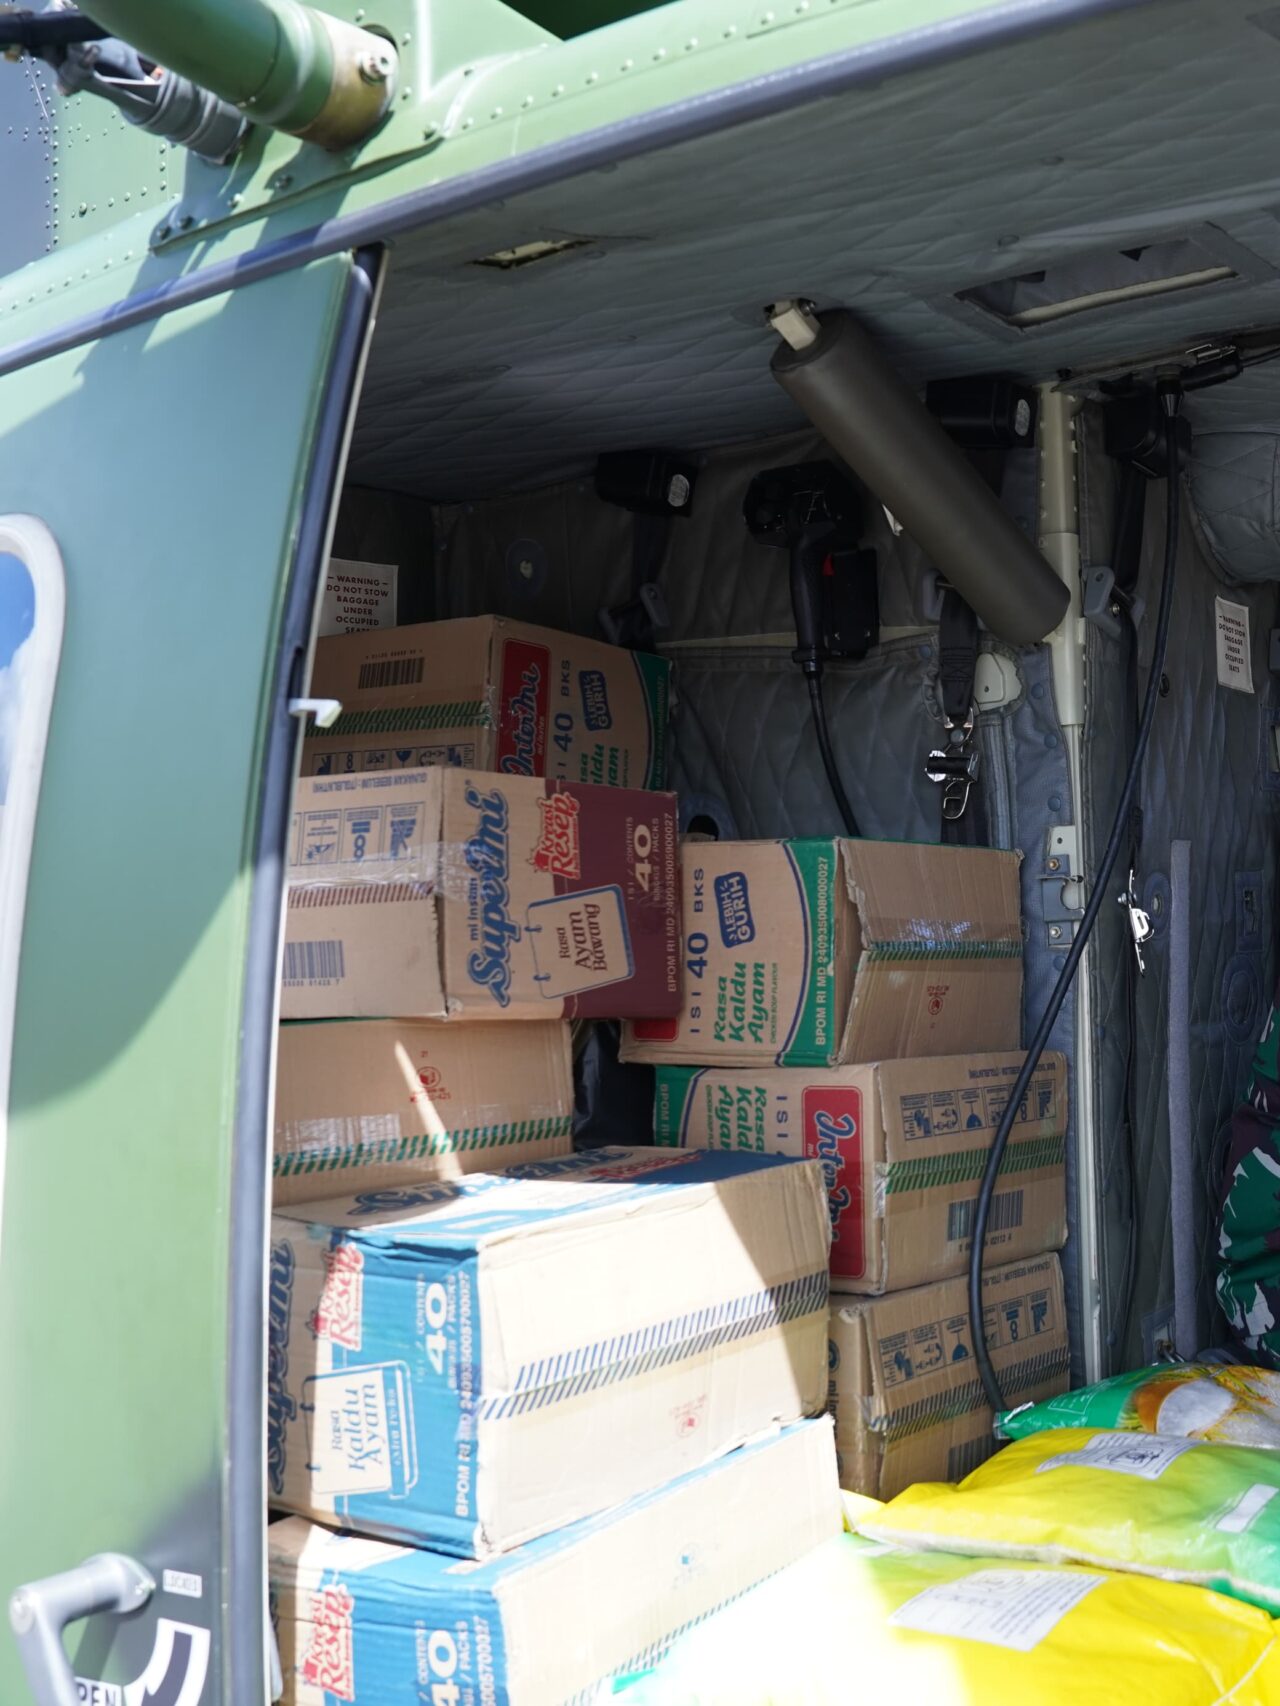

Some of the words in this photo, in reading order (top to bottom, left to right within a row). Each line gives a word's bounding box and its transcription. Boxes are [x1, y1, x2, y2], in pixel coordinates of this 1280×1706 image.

[336, 595, 379, 606] BAGGAGE
[337, 575, 380, 586] WARNING
[343, 586, 362, 594] NOT
[364, 588, 389, 597] STOW
[336, 616, 379, 626] OCCUPIED
[343, 606, 373, 615] UNDER
[561, 659, 572, 697] BKS
[593, 673, 612, 729] GURIH
[557, 712, 575, 753] 40
[592, 744, 604, 787] ldu
[540, 797, 557, 853] Kreasi
[549, 793, 582, 878] Resep
[634, 824, 651, 892] 40
[466, 784, 521, 1008] Supermi
[693, 868, 704, 914] BKS
[720, 891, 736, 931] LEBIH
[731, 876, 751, 942] GURIH
[558, 927, 571, 960] Rasa
[568, 911, 592, 969] Ayam
[584, 903, 607, 972] Bawang
[667, 920, 676, 937] MD
[667, 942, 676, 953] RI
[668, 958, 677, 993] BPOM
[687, 932, 709, 980] 40
[816, 966, 827, 987] MD
[691, 990, 702, 1034] ISI
[713, 975, 729, 1043] Rasa
[727, 961, 747, 1043] Kaldu
[745, 961, 769, 1045] Ayam
[816, 990, 827, 1003] RI
[816, 1008, 826, 1046] BPOM
[735, 1086, 753, 1152] Kald
[753, 1086, 768, 1152] Rasa
[777, 1095, 788, 1139] ISI
[814, 1110, 856, 1243] InterM
[330, 1245, 363, 1346] Resep
[425, 1282, 447, 1375] 40
[330, 1409, 343, 1451] Rasa
[342, 1388, 366, 1472] Kaldu
[360, 1383, 387, 1465] Ayam
[455, 1466, 471, 1517] BPOM
[319, 1590, 350, 1698] Resep
[76, 1683, 117, 1706] PEN
